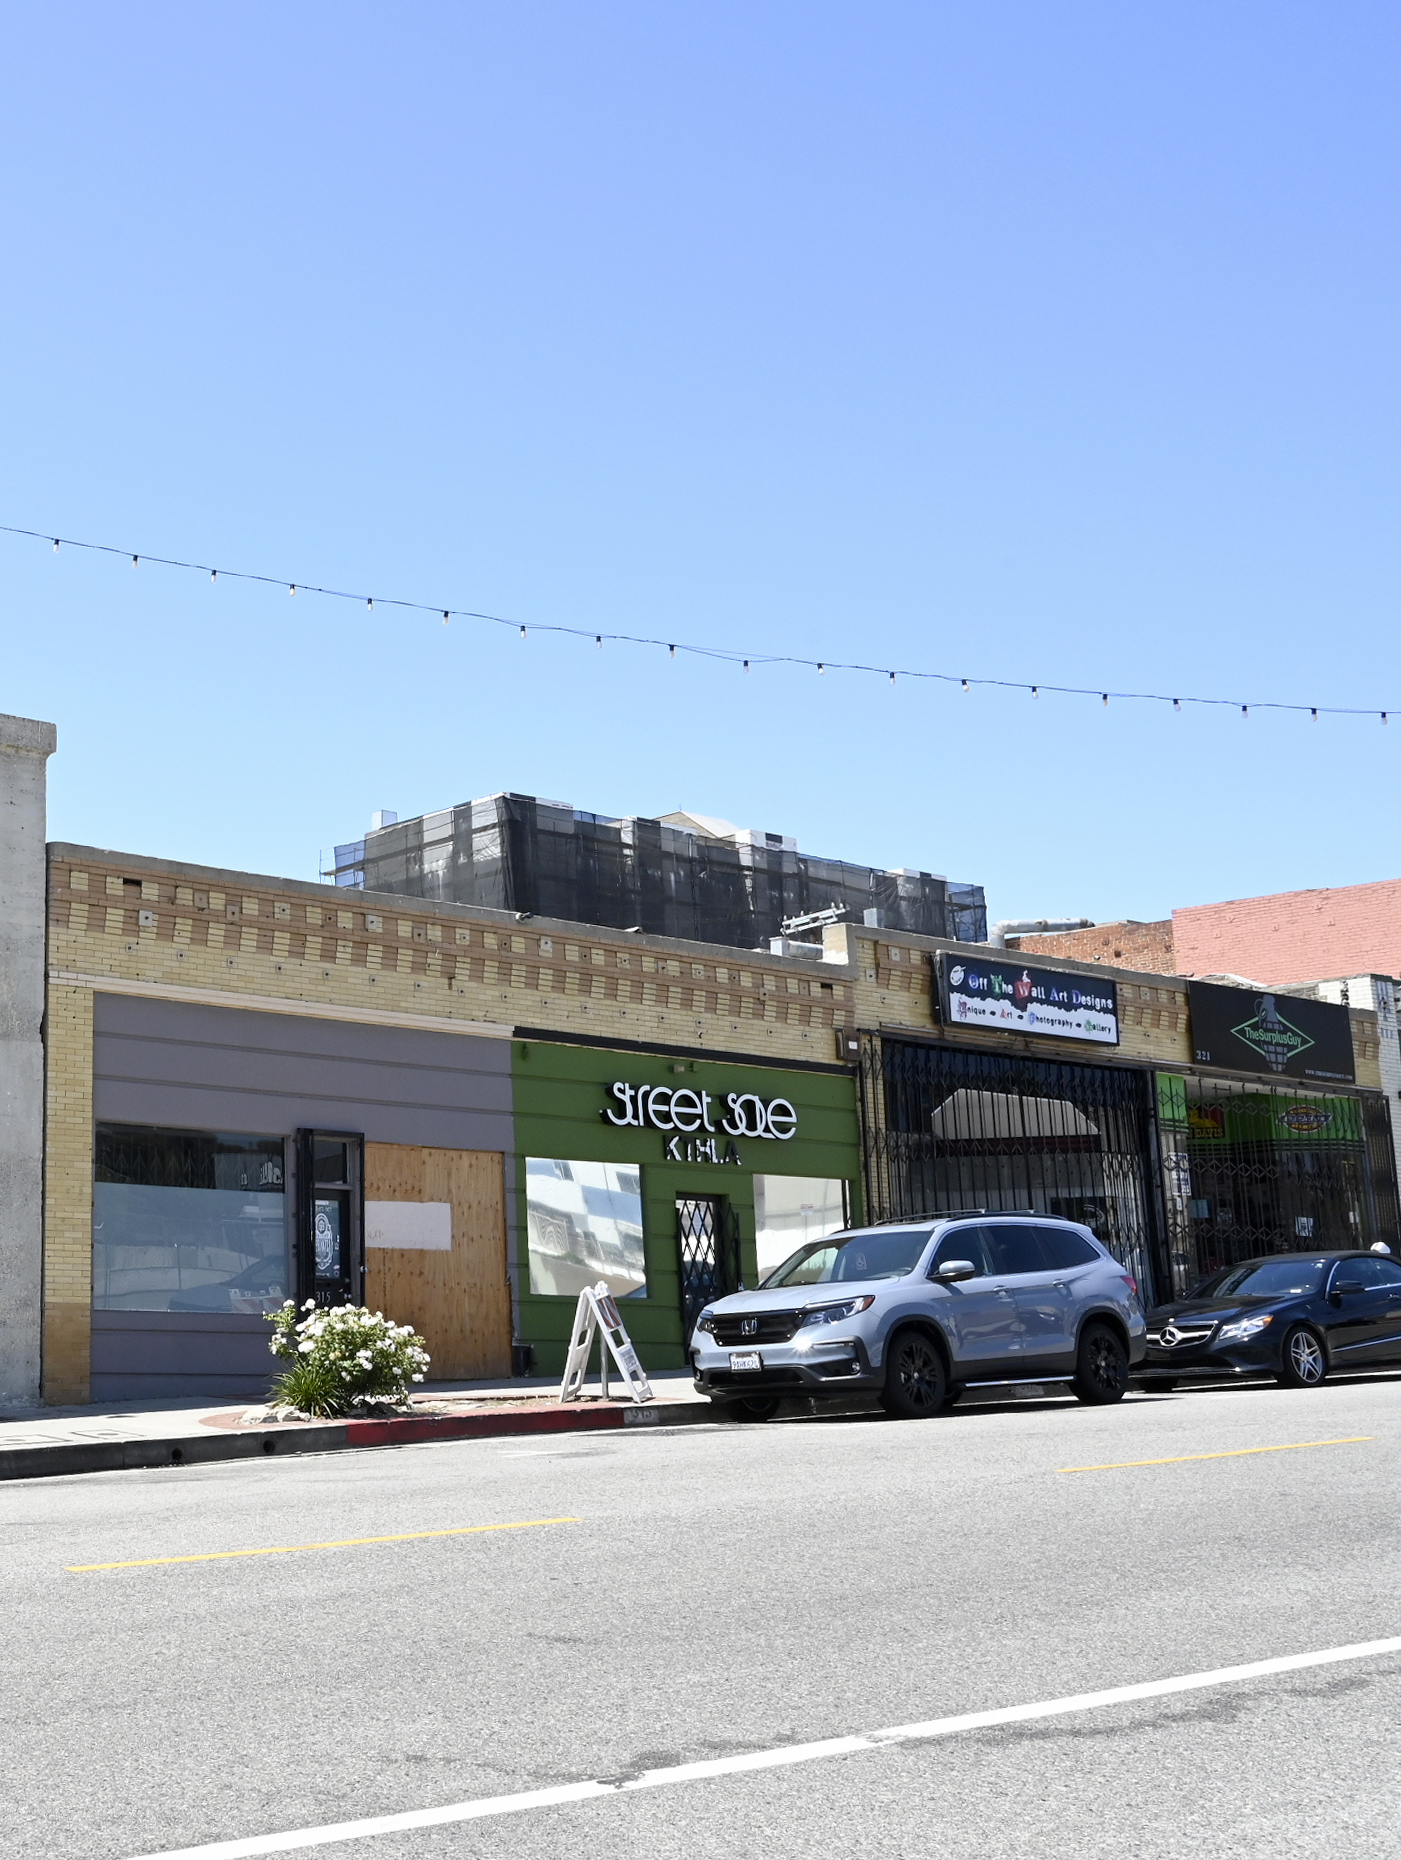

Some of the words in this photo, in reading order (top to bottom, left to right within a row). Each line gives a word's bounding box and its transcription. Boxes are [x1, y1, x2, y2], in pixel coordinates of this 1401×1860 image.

[968, 973, 988, 991] Off
[990, 972, 1013, 995] The
[1016, 984, 1046, 999] Wall
[1050, 987, 1068, 1003] Art
[1072, 989, 1114, 1010] Designs
[1244, 1026, 1302, 1048] TheSurplusGuy
[1196, 1049, 1211, 1061] 321
[316, 1291, 331, 1303] 315
